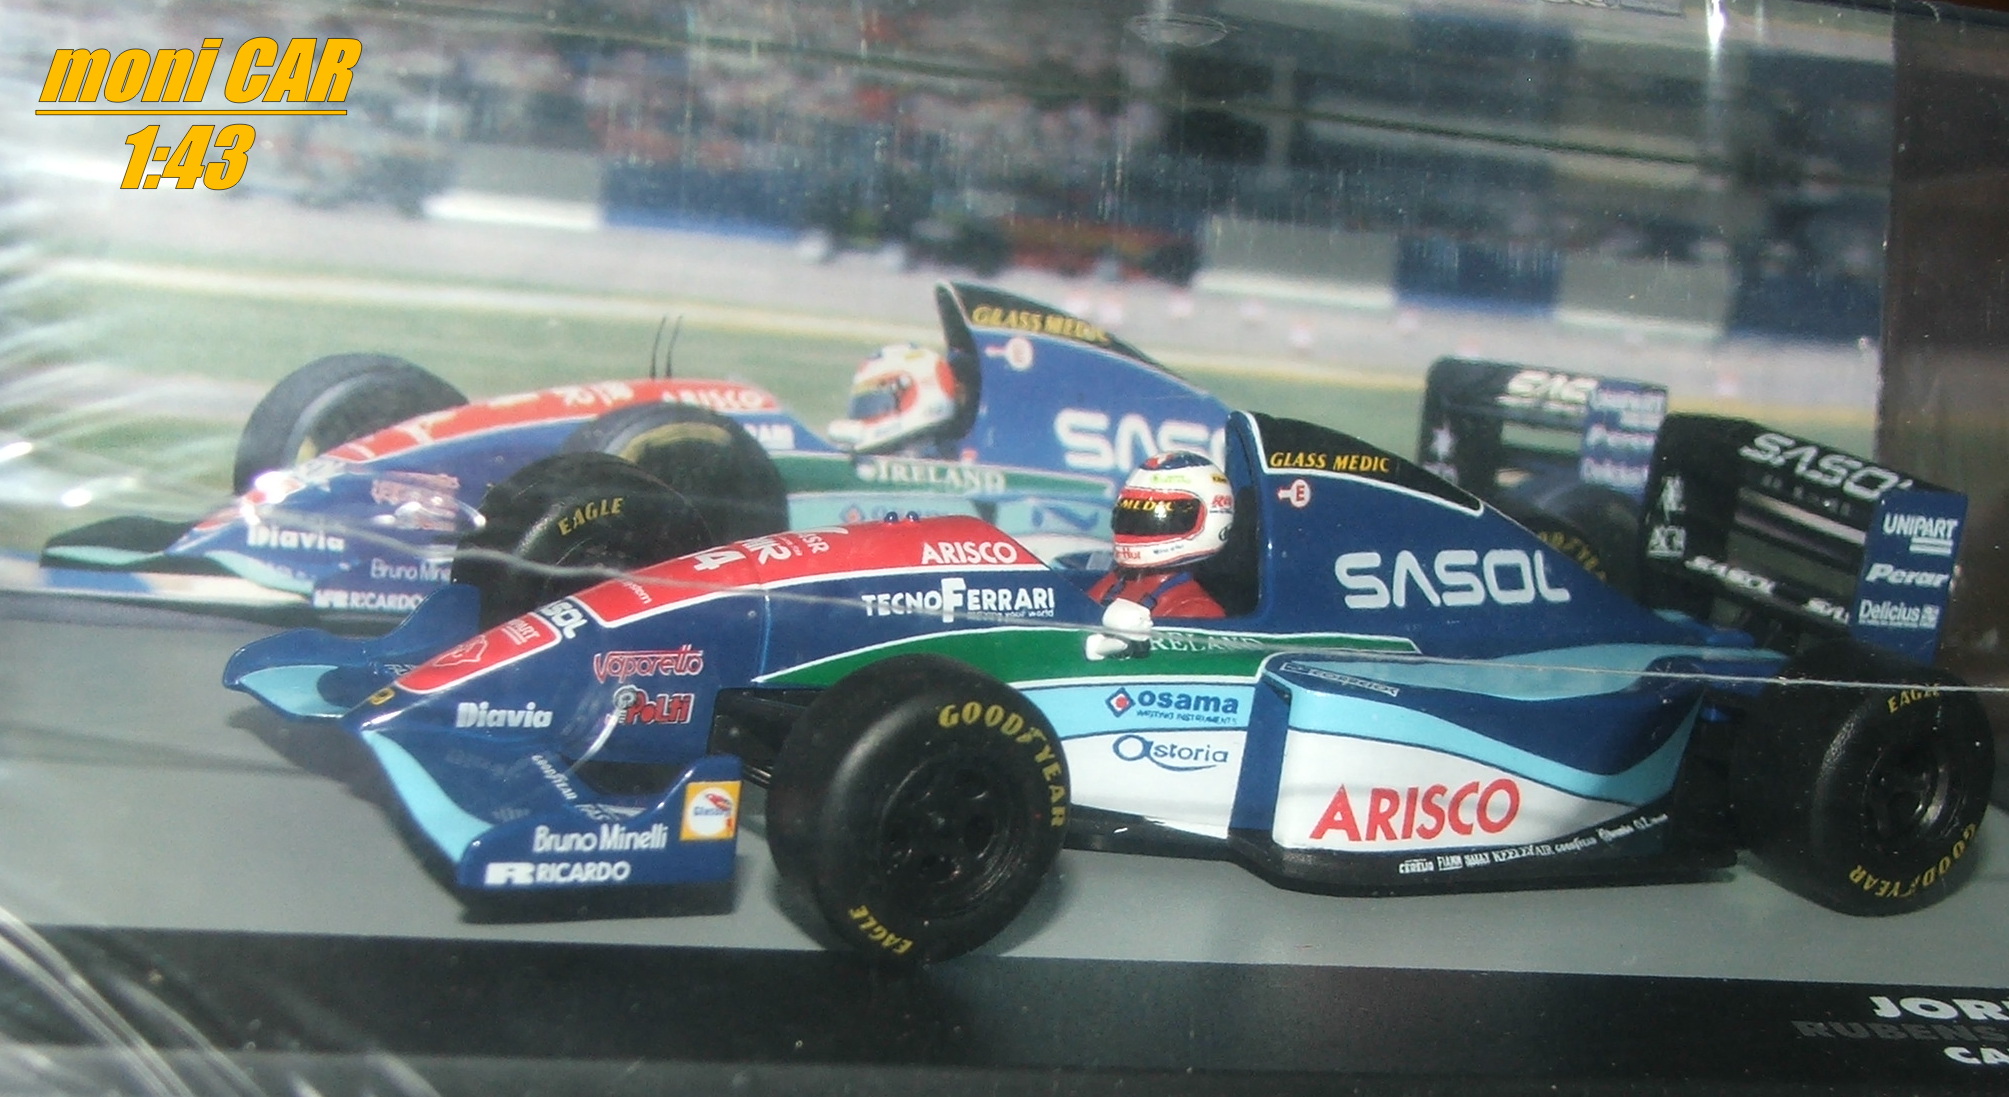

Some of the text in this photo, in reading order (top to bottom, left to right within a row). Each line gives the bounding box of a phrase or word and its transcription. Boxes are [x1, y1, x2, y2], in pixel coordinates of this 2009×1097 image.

[1269, 452, 1390, 472] GLASS MEDIC
[1739, 433, 1914, 500] SASO
[558, 498, 623, 535] EAGLE
[1882, 512, 1960, 539] UNIPART
[247, 525, 346, 552] Diavia
[921, 541, 1018, 564] ARISCO
[1335, 548, 1570, 609] SASOL
[1865, 562, 1950, 588] Perar
[593, 644, 704, 684] Vaporetto
[455, 701, 553, 729] Diavia
[1137, 690, 1239, 714] osama
[937, 701, 1068, 827] GOODYEAR
[1308, 778, 1521, 843] ARISCO
[533, 822, 669, 853] Bruno Minelli
[536, 860, 631, 883] RICARDO
[1849, 823, 1977, 898] GOODYEAR
[848, 905, 914, 954] EAGLE
[1869, 995, 2009, 1021] JOR
